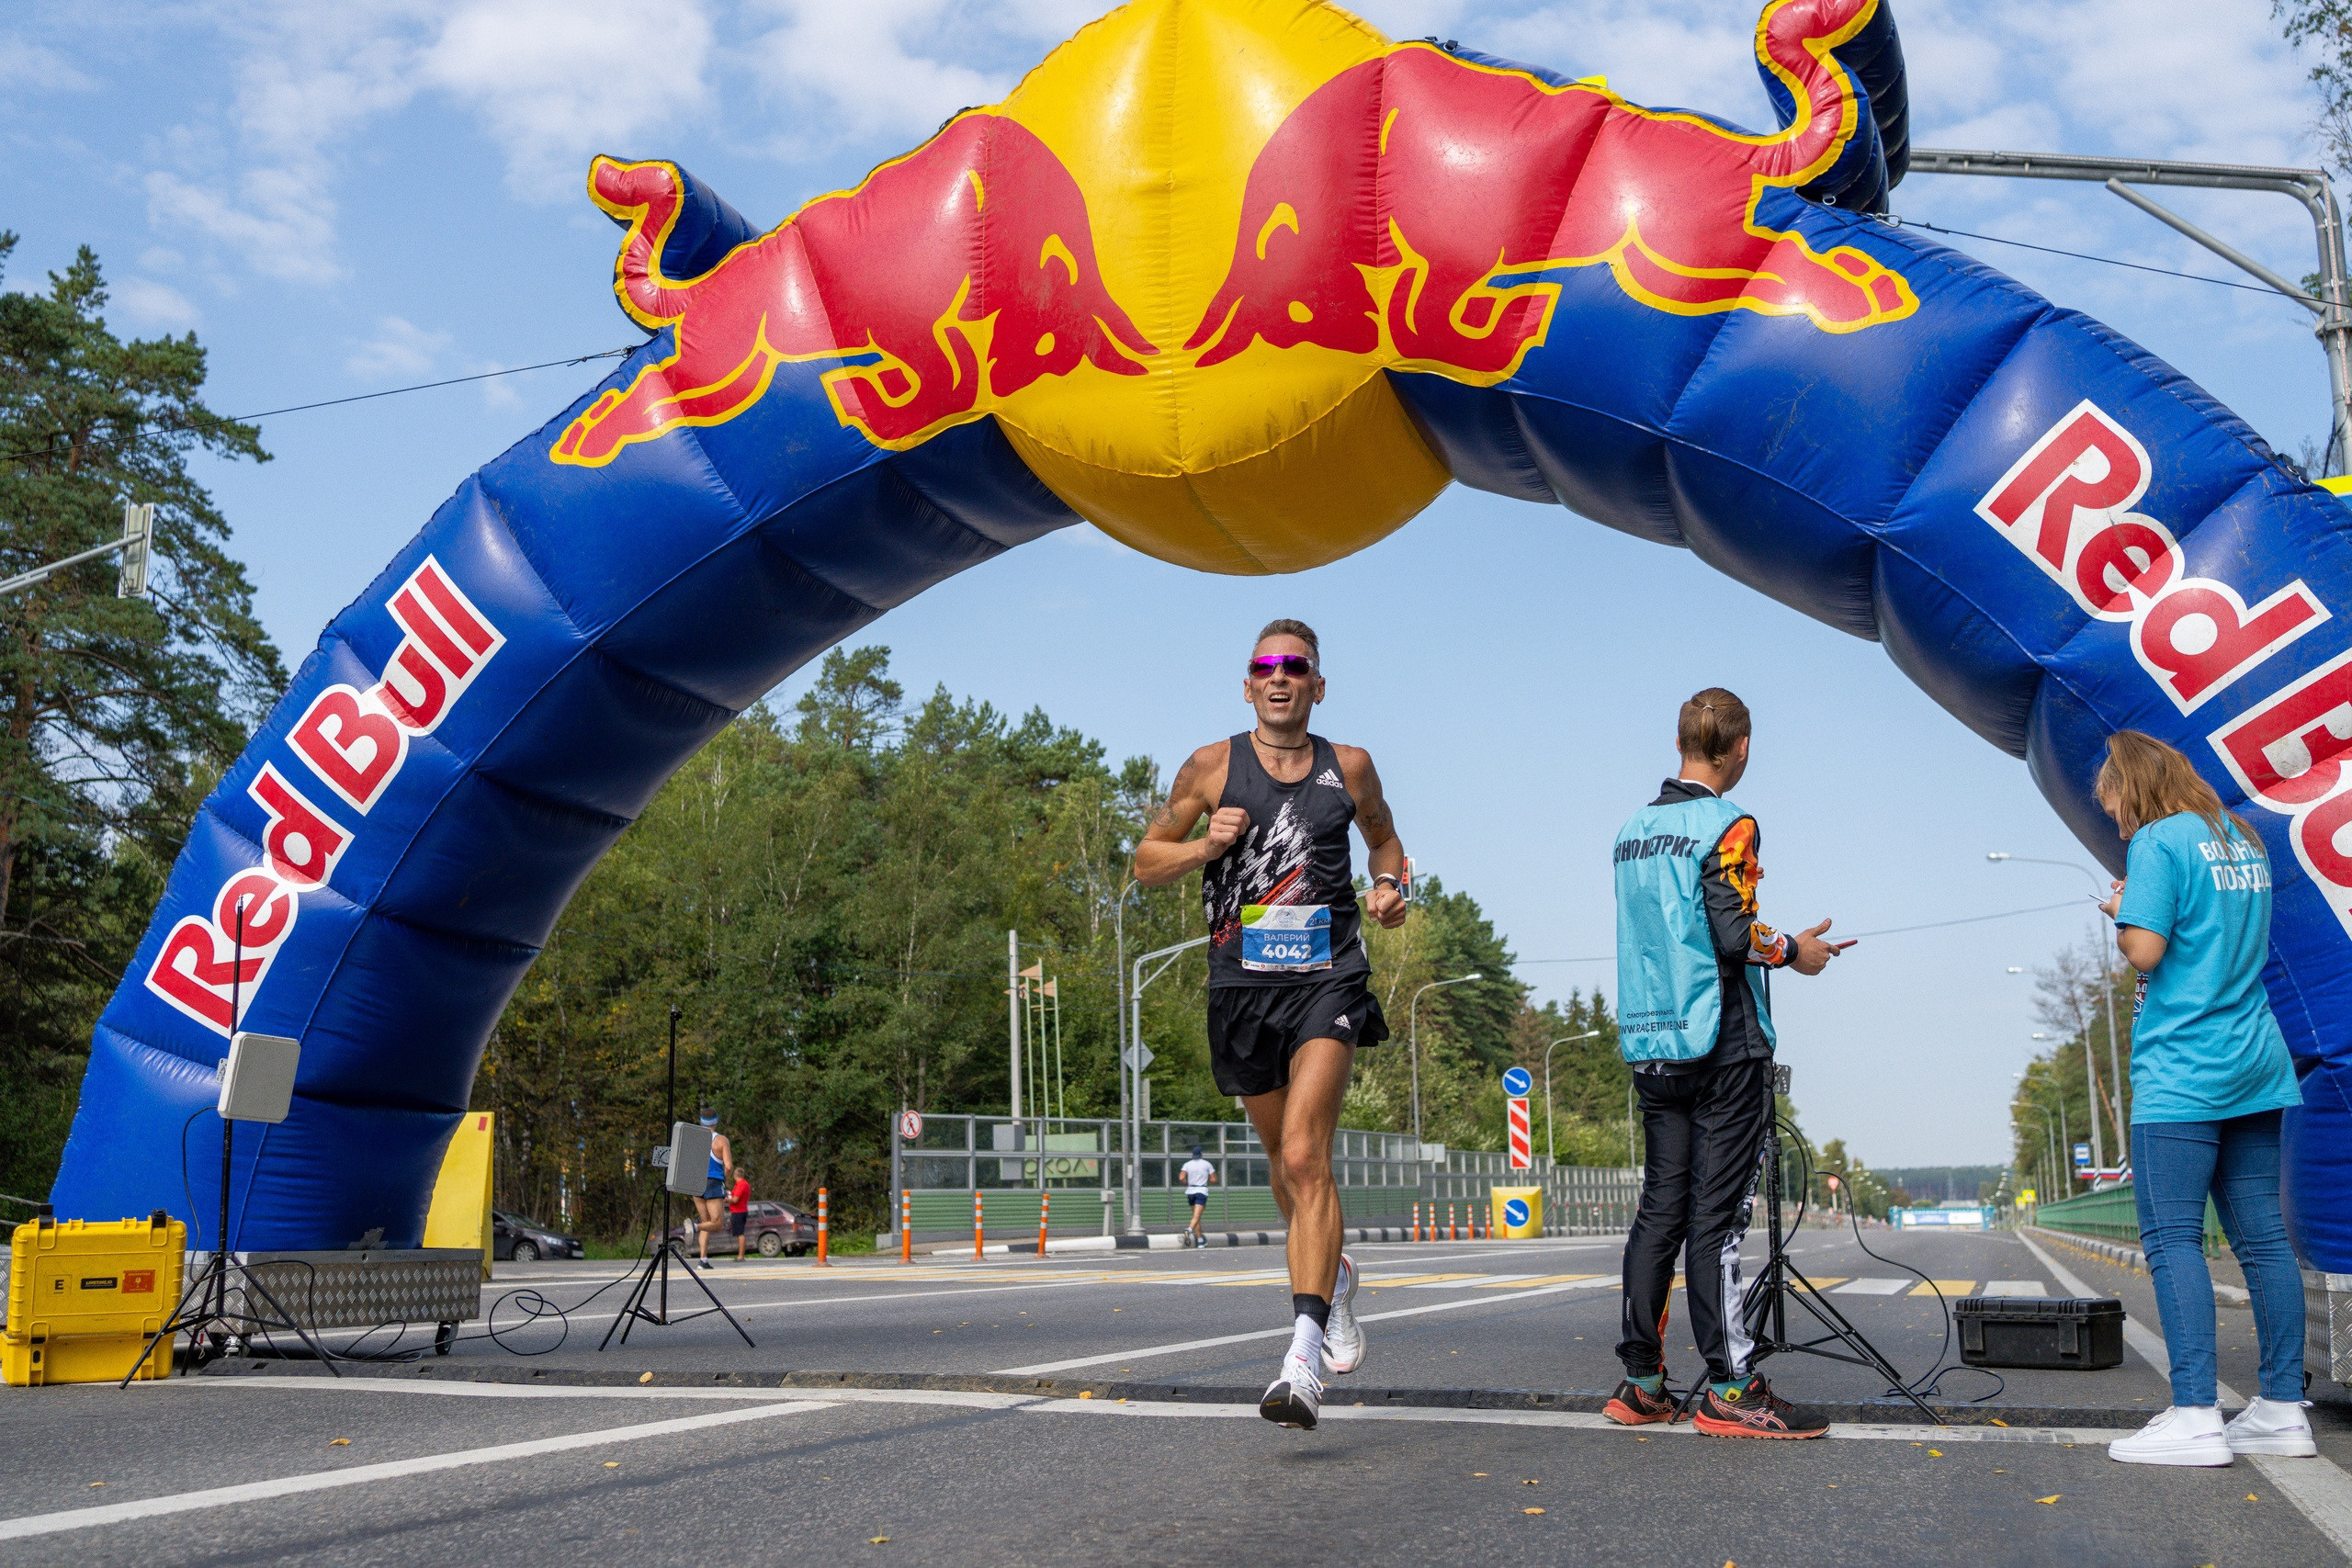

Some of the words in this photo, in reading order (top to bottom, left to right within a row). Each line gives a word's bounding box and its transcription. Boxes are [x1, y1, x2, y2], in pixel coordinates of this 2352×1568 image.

[1985, 409, 2319, 705] Red
[1316, 778, 1343, 789] adidas
[149, 769, 345, 1031] Red
[290, 562, 497, 807] Bull
[1309, 918, 1317, 926] 21
[1263, 933, 1310, 942] ВАЛЕРИЙ
[1261, 943, 1312, 959] 4042
[54, 1280, 64, 1291] E
